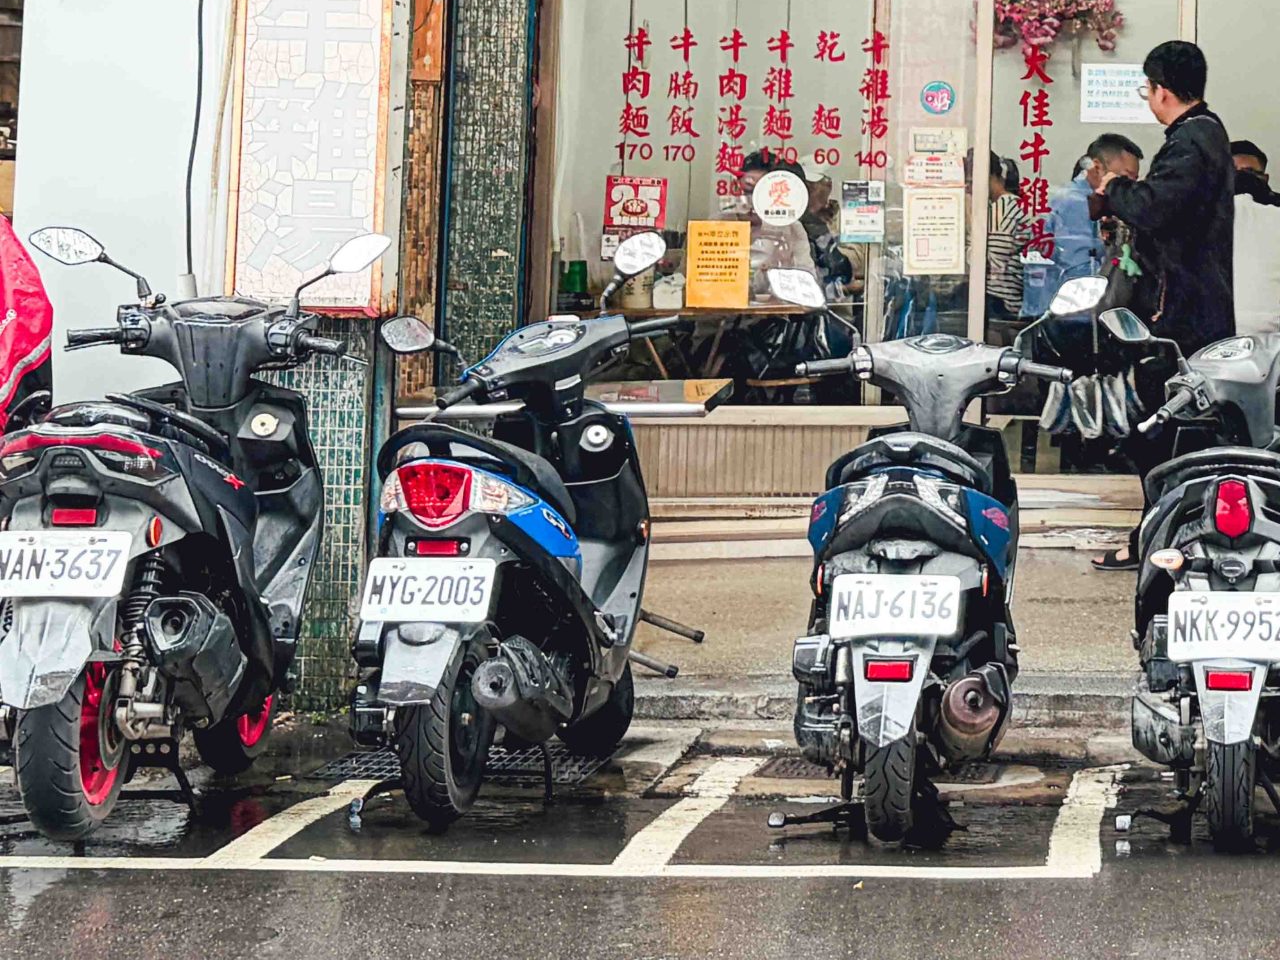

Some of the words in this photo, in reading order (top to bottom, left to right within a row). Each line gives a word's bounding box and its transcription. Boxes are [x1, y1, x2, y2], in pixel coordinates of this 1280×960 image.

[614, 142, 653, 161] 170
[663, 144, 695, 162] 170
[760, 146, 798, 165] 170
[814, 148, 840, 166] 60
[854, 150, 888, 168] 140
[1016, 44, 1055, 259] 大佳牛雜湯
[717, 180, 743, 197] 80
